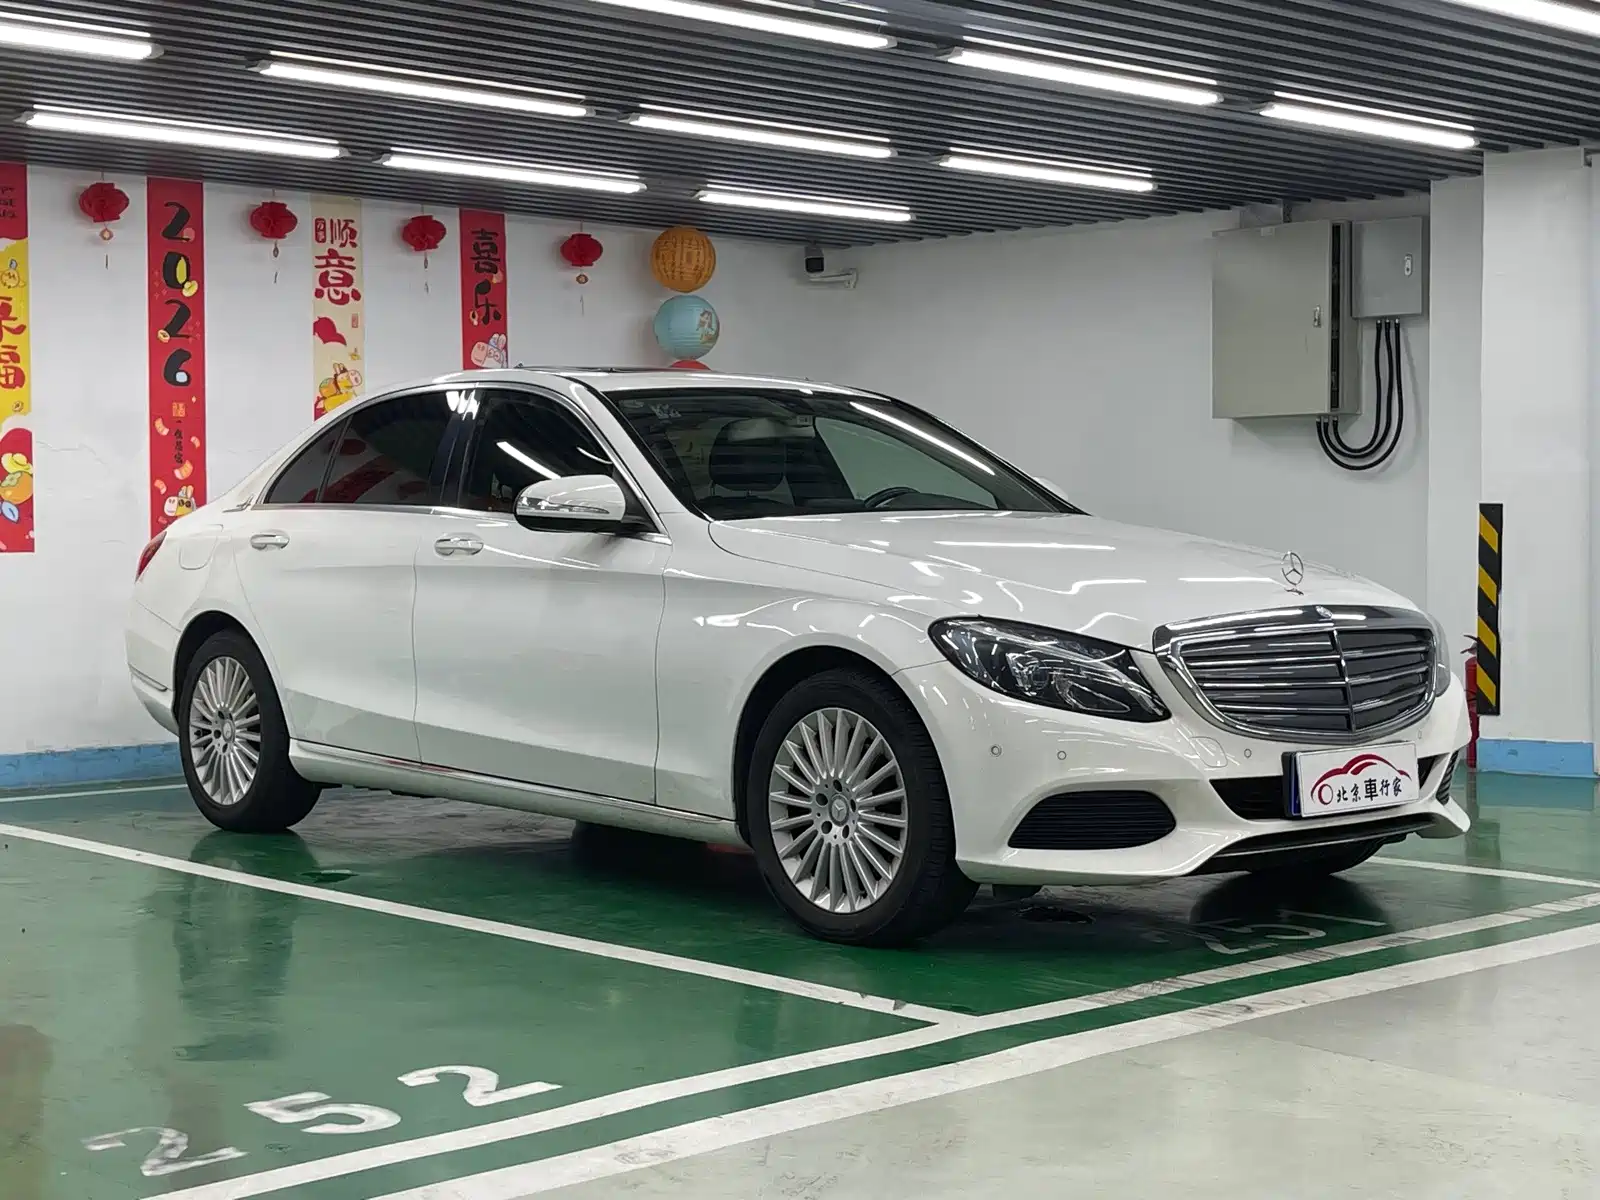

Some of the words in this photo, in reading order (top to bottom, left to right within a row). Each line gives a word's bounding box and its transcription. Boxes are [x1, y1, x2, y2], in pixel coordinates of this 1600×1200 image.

[161, 201, 192, 387] 2026
[314, 218, 362, 306] 顺意
[470, 228, 502, 326] 喜乐
[1336, 776, 1403, 803] 北京車行家
[81, 1065, 563, 1177] 252
